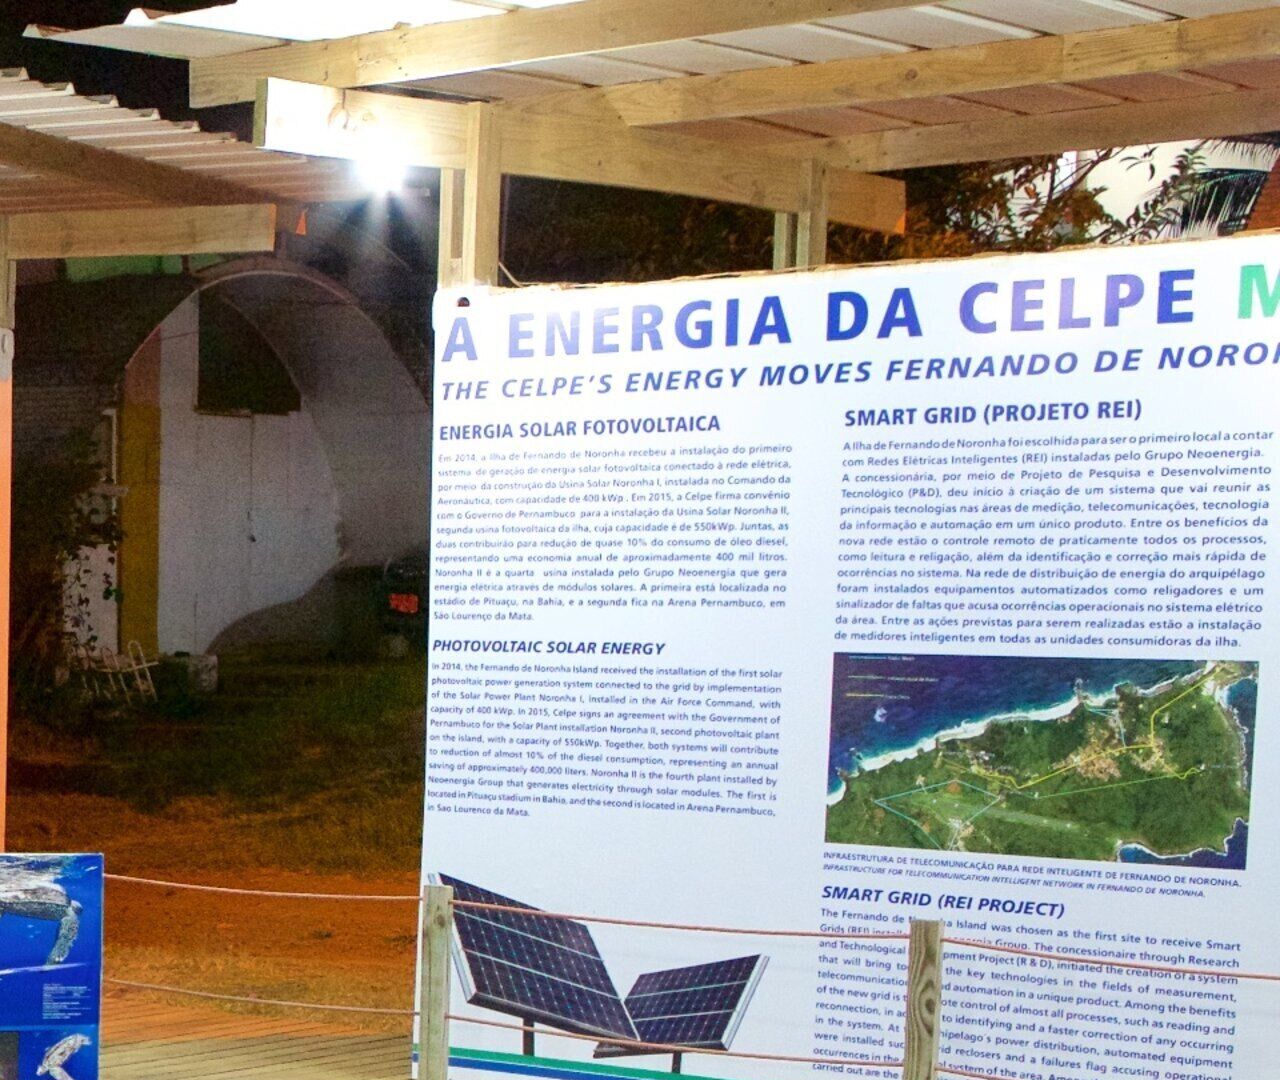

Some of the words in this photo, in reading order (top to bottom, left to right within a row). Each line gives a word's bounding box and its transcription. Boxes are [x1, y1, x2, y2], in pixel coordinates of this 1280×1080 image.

[509, 297, 792, 356] ENERGIA
[826, 288, 923, 341] DA
[958, 270, 1196, 332] CELPE
[442, 381, 489, 400] THE
[501, 374, 613, 397] CELPE'S
[625, 368, 748, 392] ENERGY
[759, 361, 872, 386] MOVES
[885, 353, 1078, 380] FERNANDO
[1093, 348, 1143, 373] DE
[1157, 342, 1280, 369] NORO
[845, 408, 916, 427] SMART
[924, 406, 976, 424] GRID
[983, 402, 1089, 423] (PROJETO
[1098, 399, 1141, 420] REI)
[439, 424, 514, 441] ENERGIA
[519, 421, 577, 438] SOLAR
[583, 415, 721, 435] FOTOVOLTAICA
[837, 553, 868, 562] como
[870, 552, 906, 562] leitura
[908, 554, 916, 562] e
[918, 551, 973, 564] religação,
[976, 552, 1004, 562] além
[1007, 551, 1023, 562] da
[1025, 551, 1102, 563] identificação
[1104, 553, 1113, 562] e
[1116, 551, 1169, 563] correção
[1172, 551, 1201, 562] mais
[1205, 550, 1246, 563] rápida
[1249, 550, 1267, 561] de
[836, 583, 869, 593] foram
[873, 584, 930, 594] instalados
[933, 585, 1015, 596] equipamentos
[1020, 585, 1109, 596] automatizados
[1113, 587, 1148, 596] como
[1153, 585, 1224, 598] religadores
[1229, 587, 1238, 596] e
[1243, 587, 1264, 596] um
[432, 639, 543, 653] PHOTOVOLTAIC
[546, 641, 597, 654] SOLAR
[601, 642, 666, 655] ENERGY
[431, 677, 482, 686] photovoltaic
[484, 679, 512, 687] power
[514, 679, 561, 689] generation
[563, 680, 593, 690] system
[595, 681, 641, 690] connected
[643, 682, 653, 691] to
[655, 681, 670, 691] the
[672, 682, 691, 693] grid
[693, 683, 705, 693] by
[707, 684, 782, 694] implementation
[821, 907, 839, 919] The
[841, 910, 889, 922] Fernando
[891, 914, 905, 924] de
[822, 886, 883, 902] SMART
[888, 891, 932, 906] GRID
[937, 894, 973, 910] (REI
[977, 898, 1065, 918] PROJECT)
[956, 920, 988, 931] Island
[990, 924, 1013, 933] was
[1015, 925, 1054, 936] chosen
[1056, 929, 1069, 938] as
[1072, 929, 1091, 940] the
[1094, 930, 1118, 942] first
[1120, 933, 1142, 944] site
[1144, 936, 1158, 945] to
[1160, 938, 1203, 949] receive
[1205, 939, 1241, 952] Smart
[945, 966, 962, 977] the
[967, 967, 986, 981] key
[990, 971, 1058, 986] technologies
[1063, 977, 1074, 987] in
[1079, 979, 1097, 990] the
[1102, 980, 1133, 993] fields
[1137, 984, 1150, 994] of
[1154, 988, 1237, 1002] measurement,
[941, 1014, 953, 1023] to
[955, 1015, 1013, 1032] identifying
[1015, 1023, 1036, 1032] and
[1048, 1024, 1079, 1037] faster
[1081, 1030, 1138, 1042] correction
[1140, 1034, 1153, 1044] of
[1155, 1037, 1177, 1049] any
[1179, 1040, 1235, 1055] occurring
